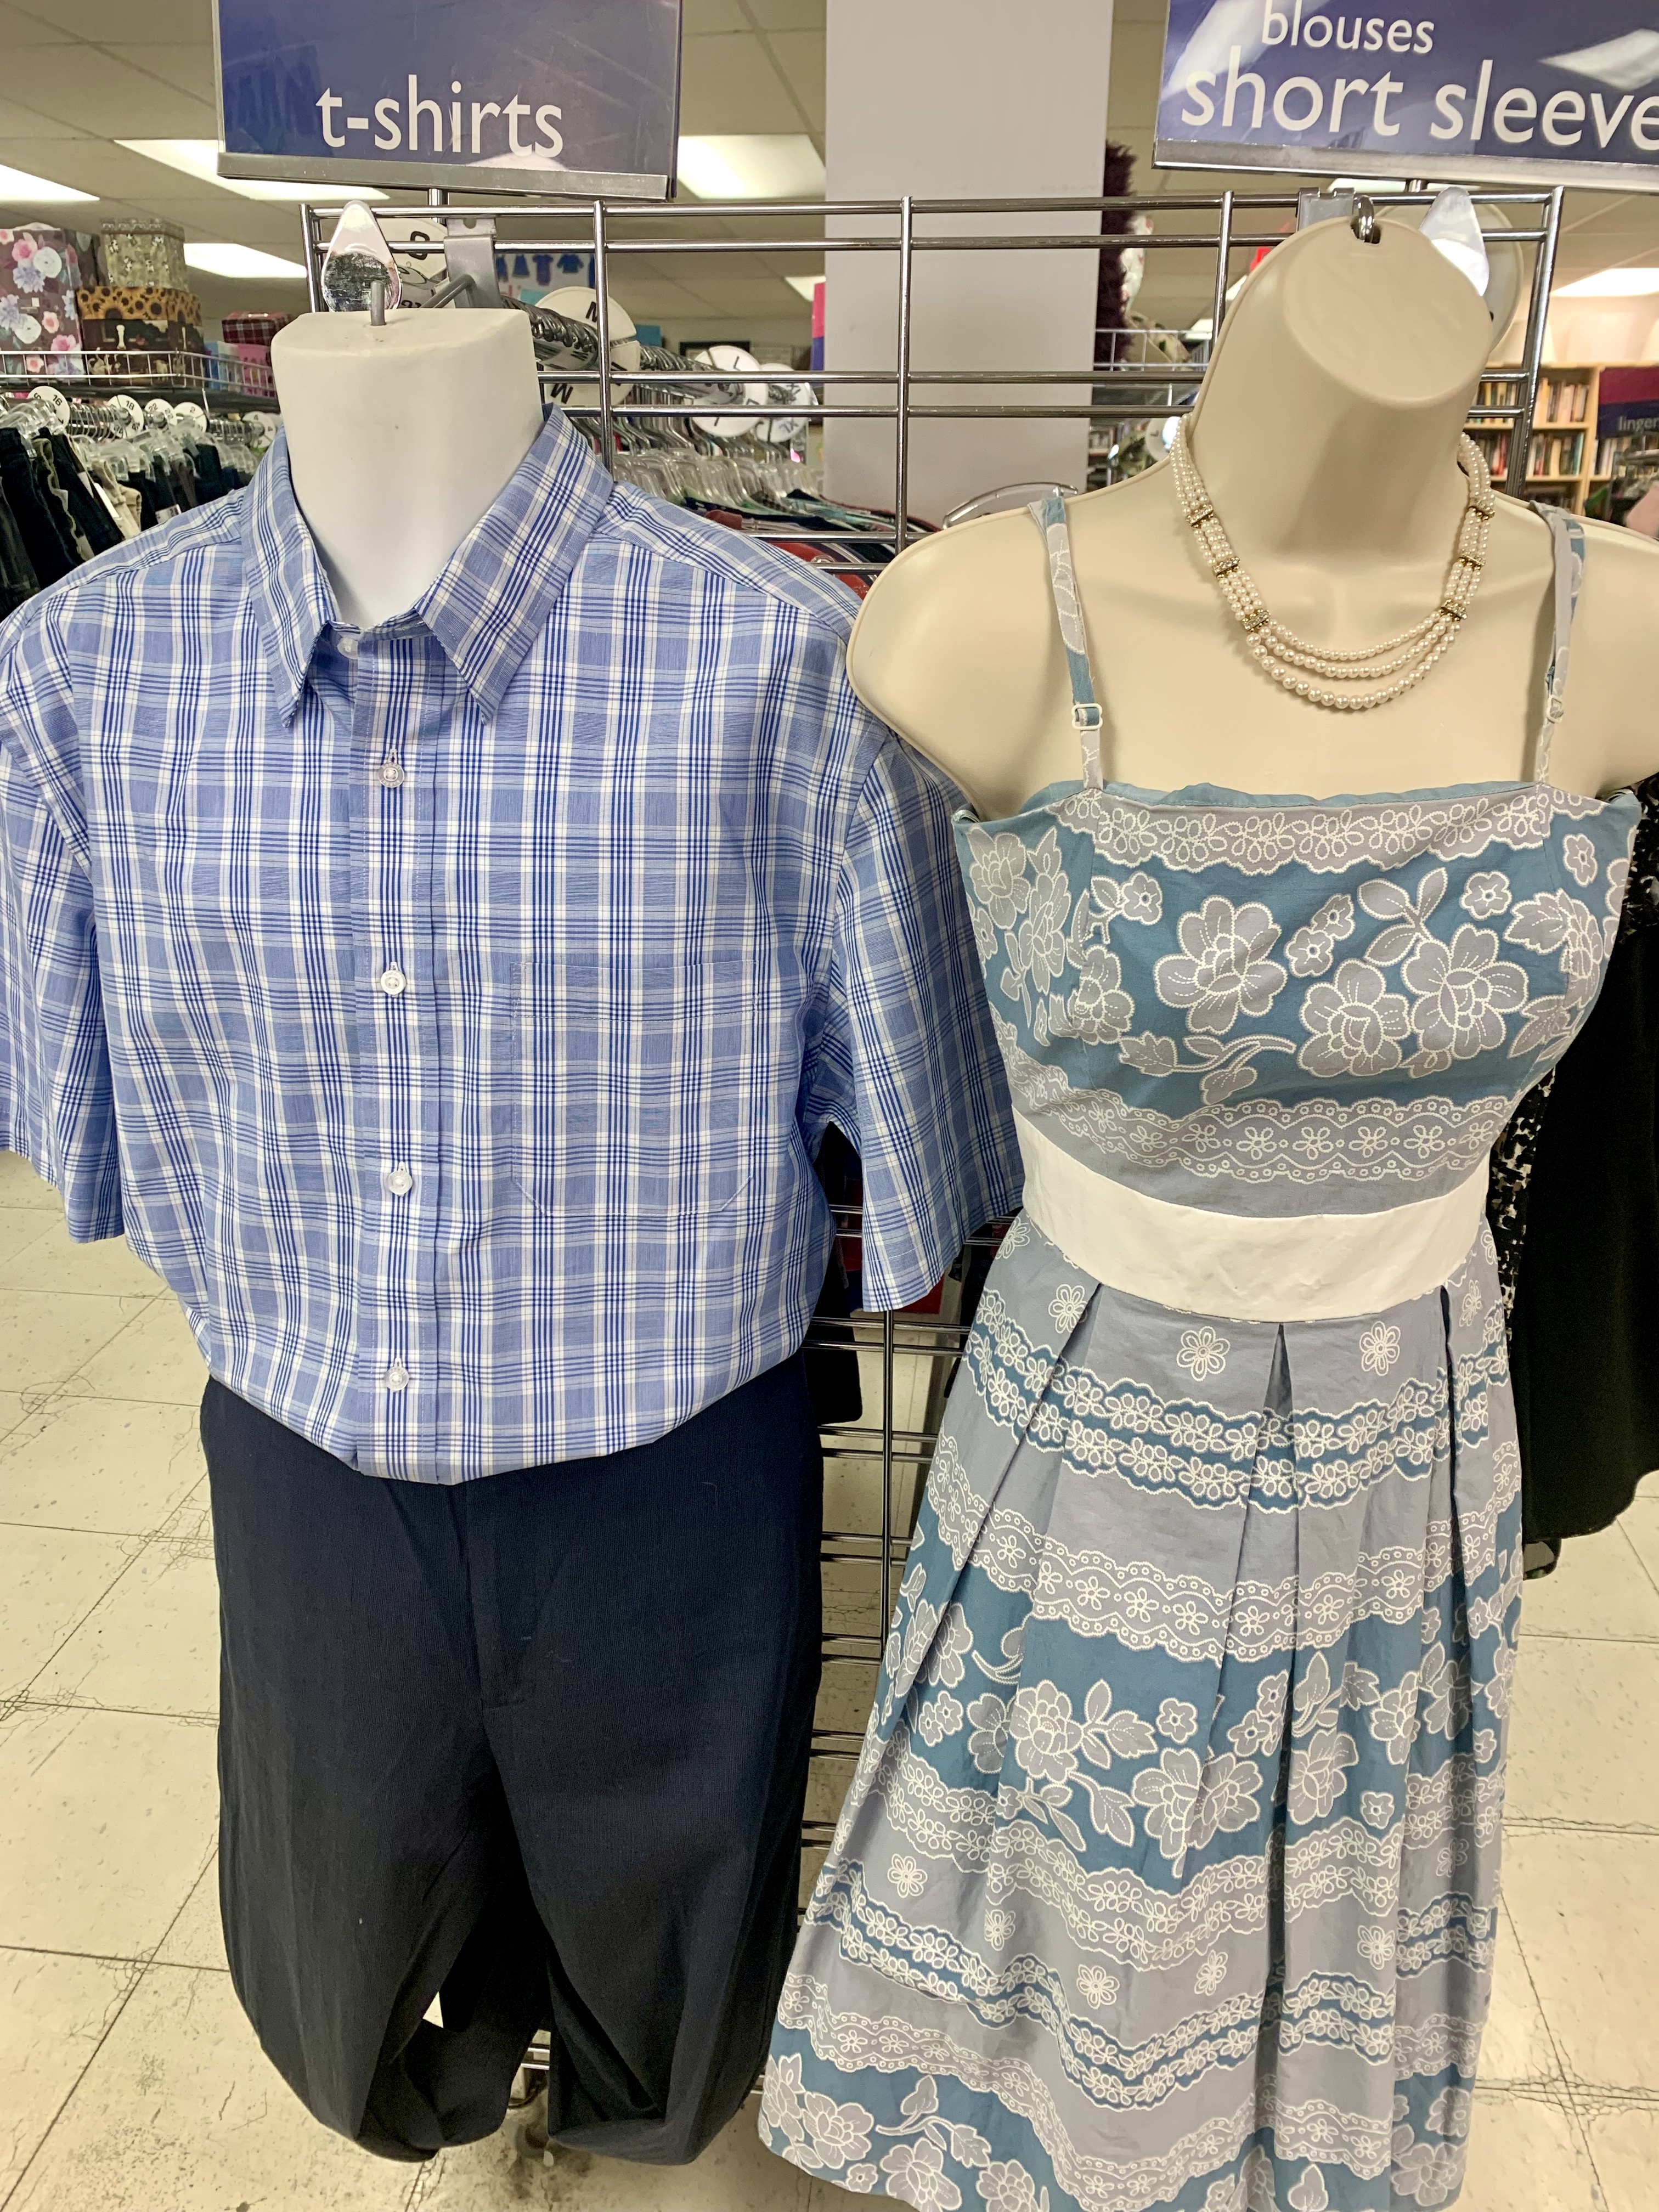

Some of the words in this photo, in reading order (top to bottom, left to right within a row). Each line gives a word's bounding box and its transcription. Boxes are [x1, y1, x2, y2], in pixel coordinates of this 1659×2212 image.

[1262, 0, 1435, 54] blouses
[315, 74, 564, 158] t-shirts
[1181, 45, 1404, 137] short
[53, 394, 63, 407] 16
[126, 400, 135, 410] 18
